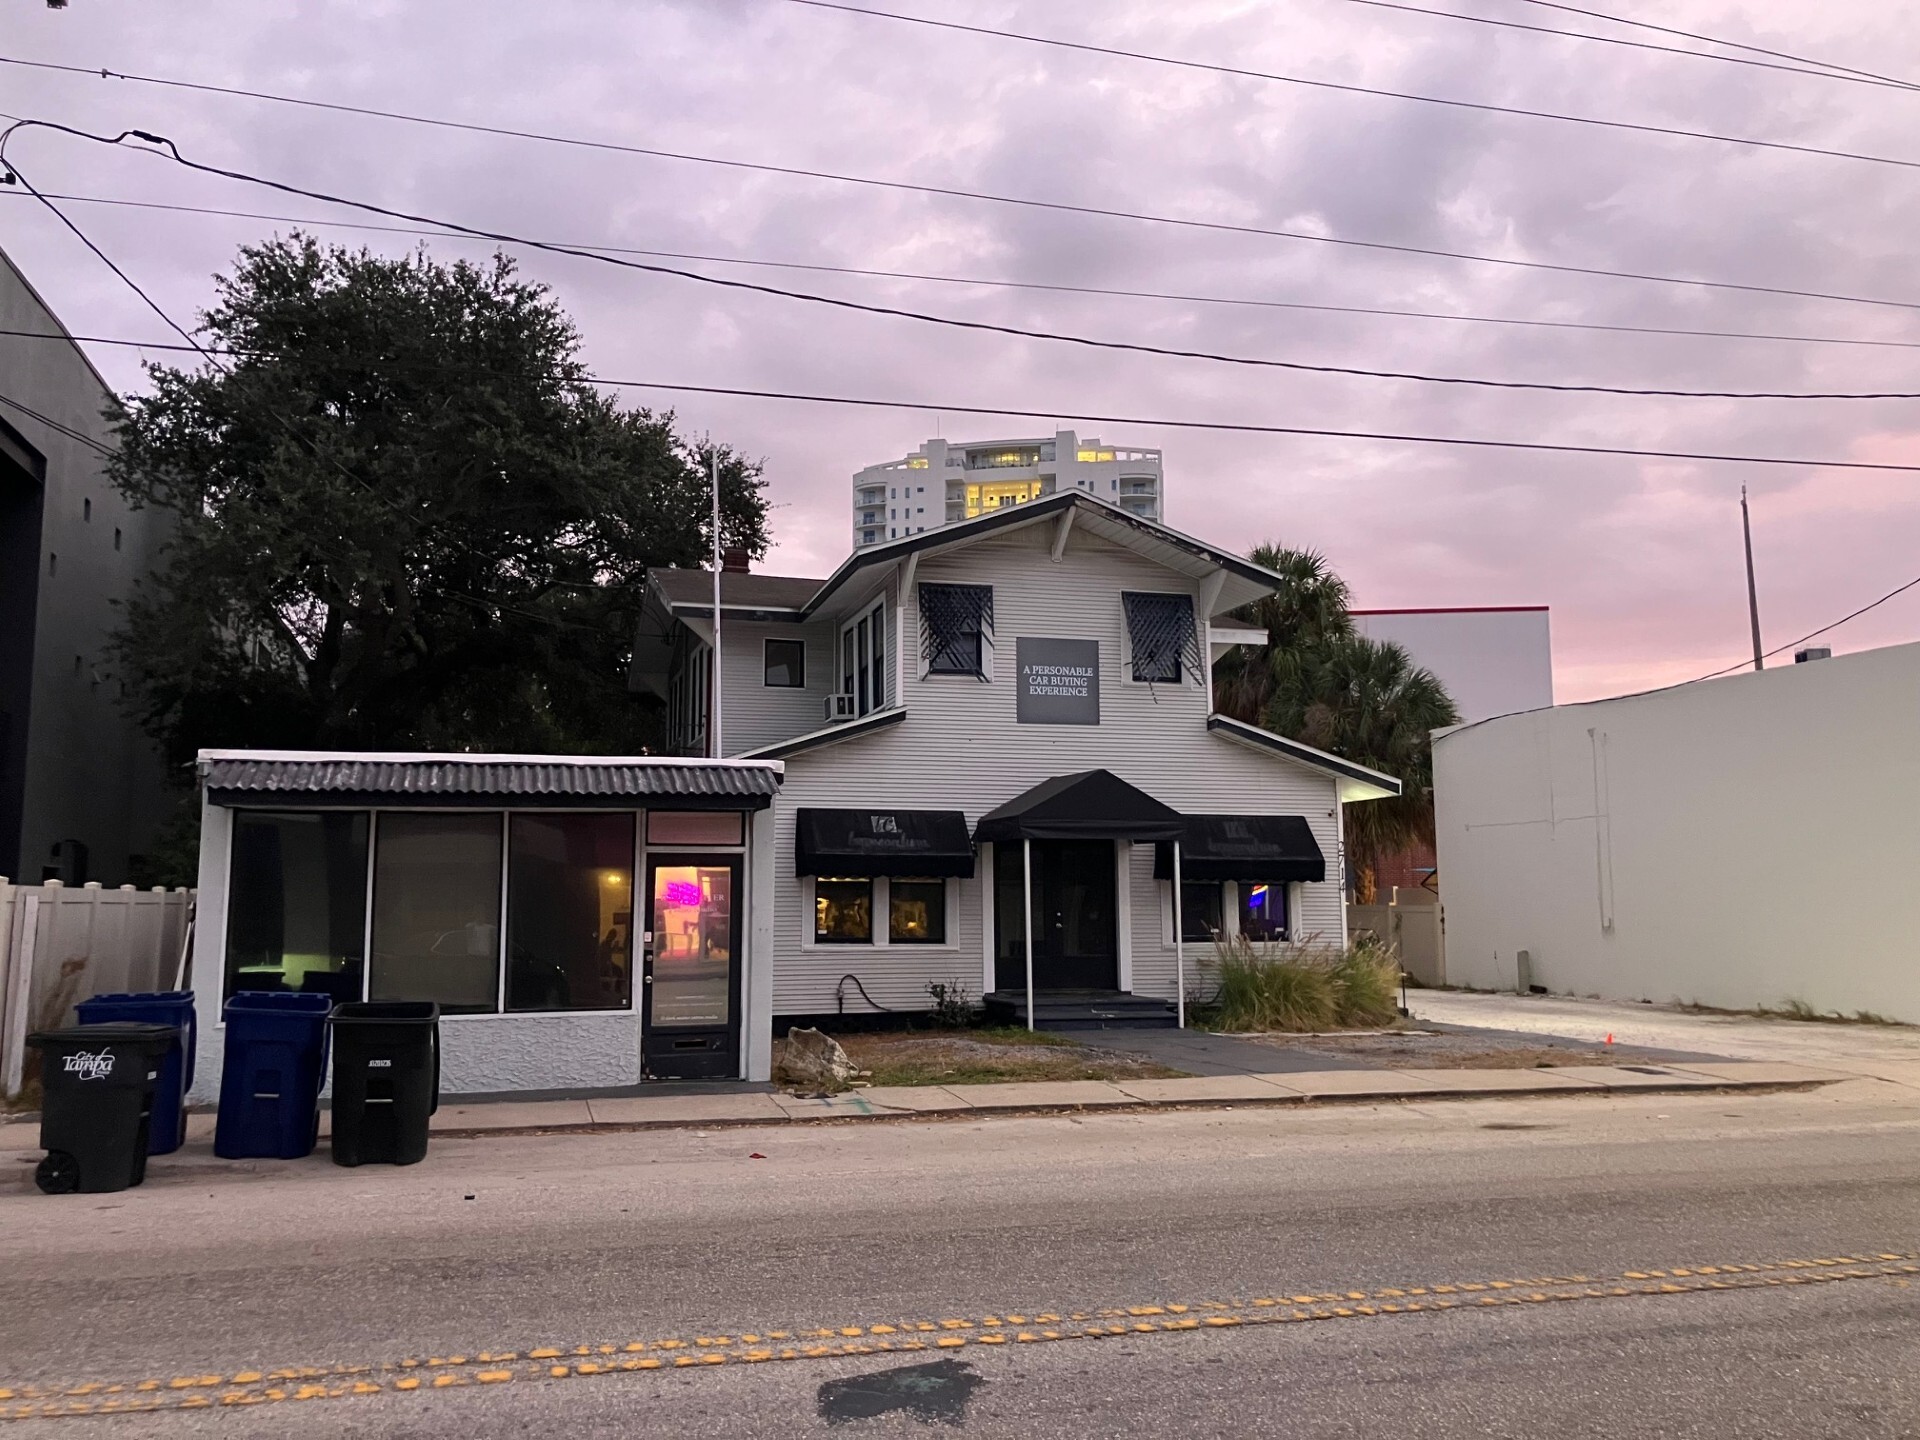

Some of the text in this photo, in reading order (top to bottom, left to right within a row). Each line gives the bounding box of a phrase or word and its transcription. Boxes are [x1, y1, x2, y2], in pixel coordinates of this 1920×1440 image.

[1023, 665, 1093, 677] A PERSONABLE
[1029, 675, 1088, 687] CAR BUYING
[1029, 686, 1088, 697] EXPERIENCE
[1338, 840, 1346, 893] 2714
[62, 1056, 113, 1077] Tampa
